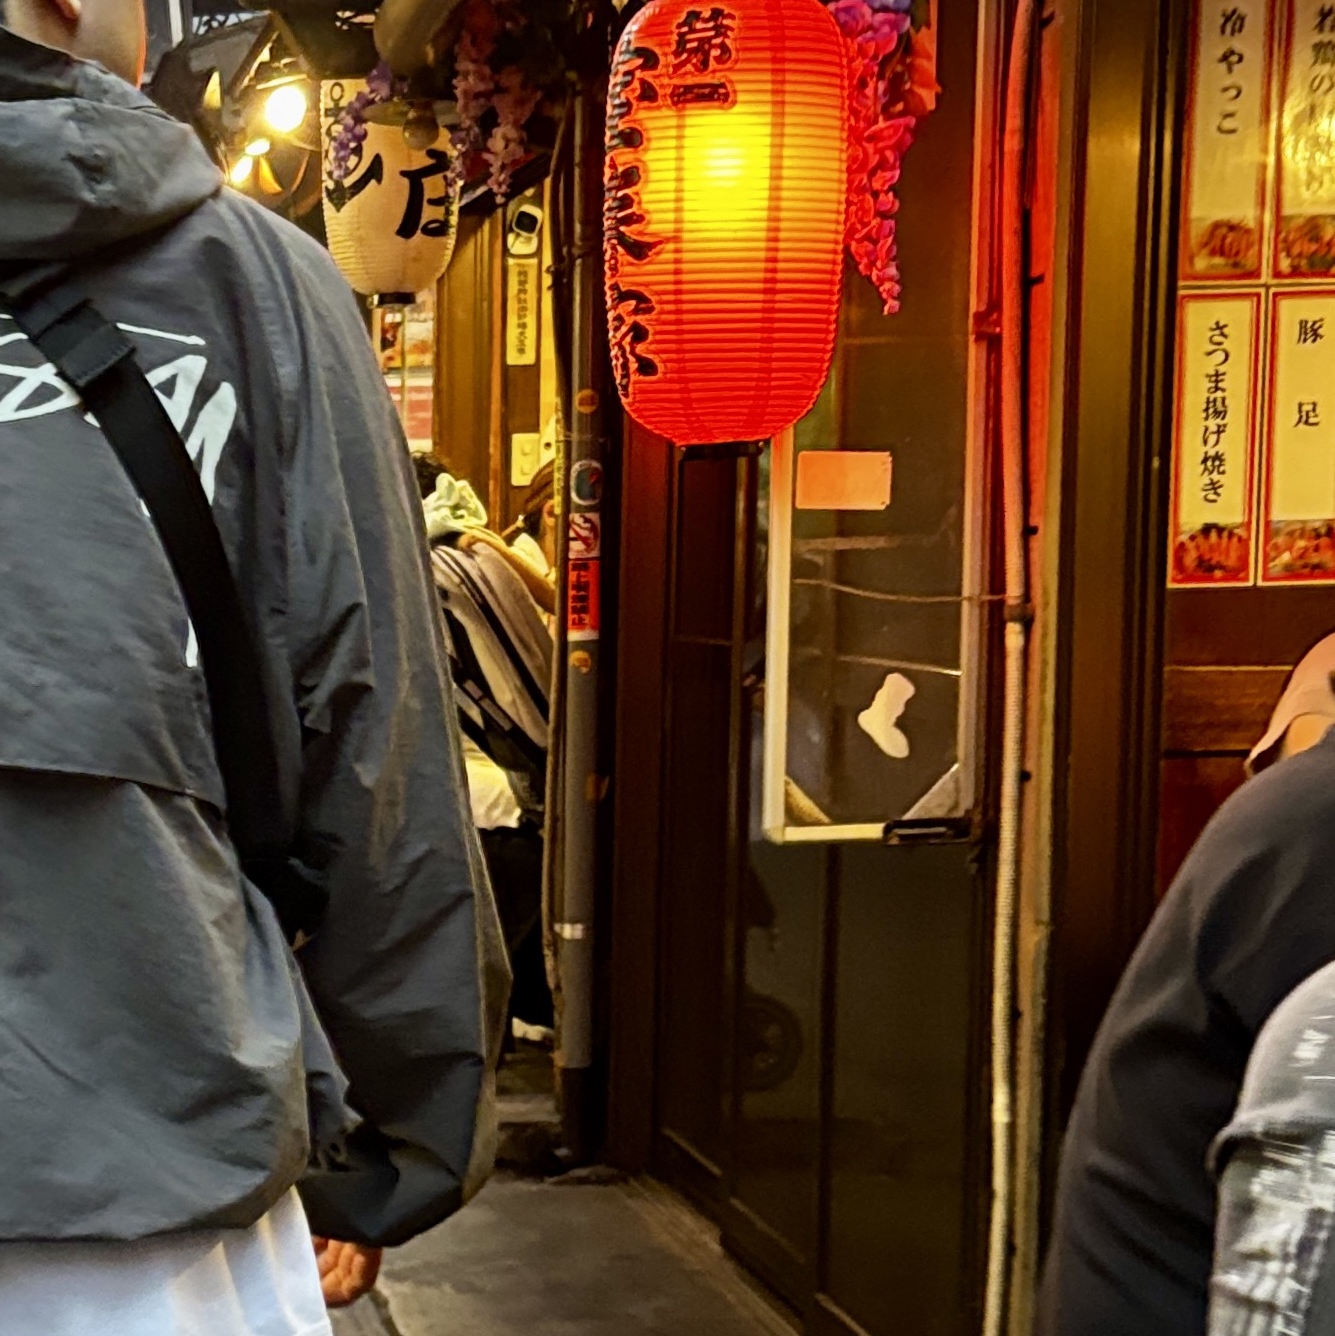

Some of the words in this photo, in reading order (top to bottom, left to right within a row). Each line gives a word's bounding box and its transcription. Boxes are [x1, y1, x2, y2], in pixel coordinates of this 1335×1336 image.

[669, 8, 736, 108] 第一
[1217, 6, 1247, 135] 冷やっこ
[1200, 320, 1231, 503] さつま揚げ焼き
